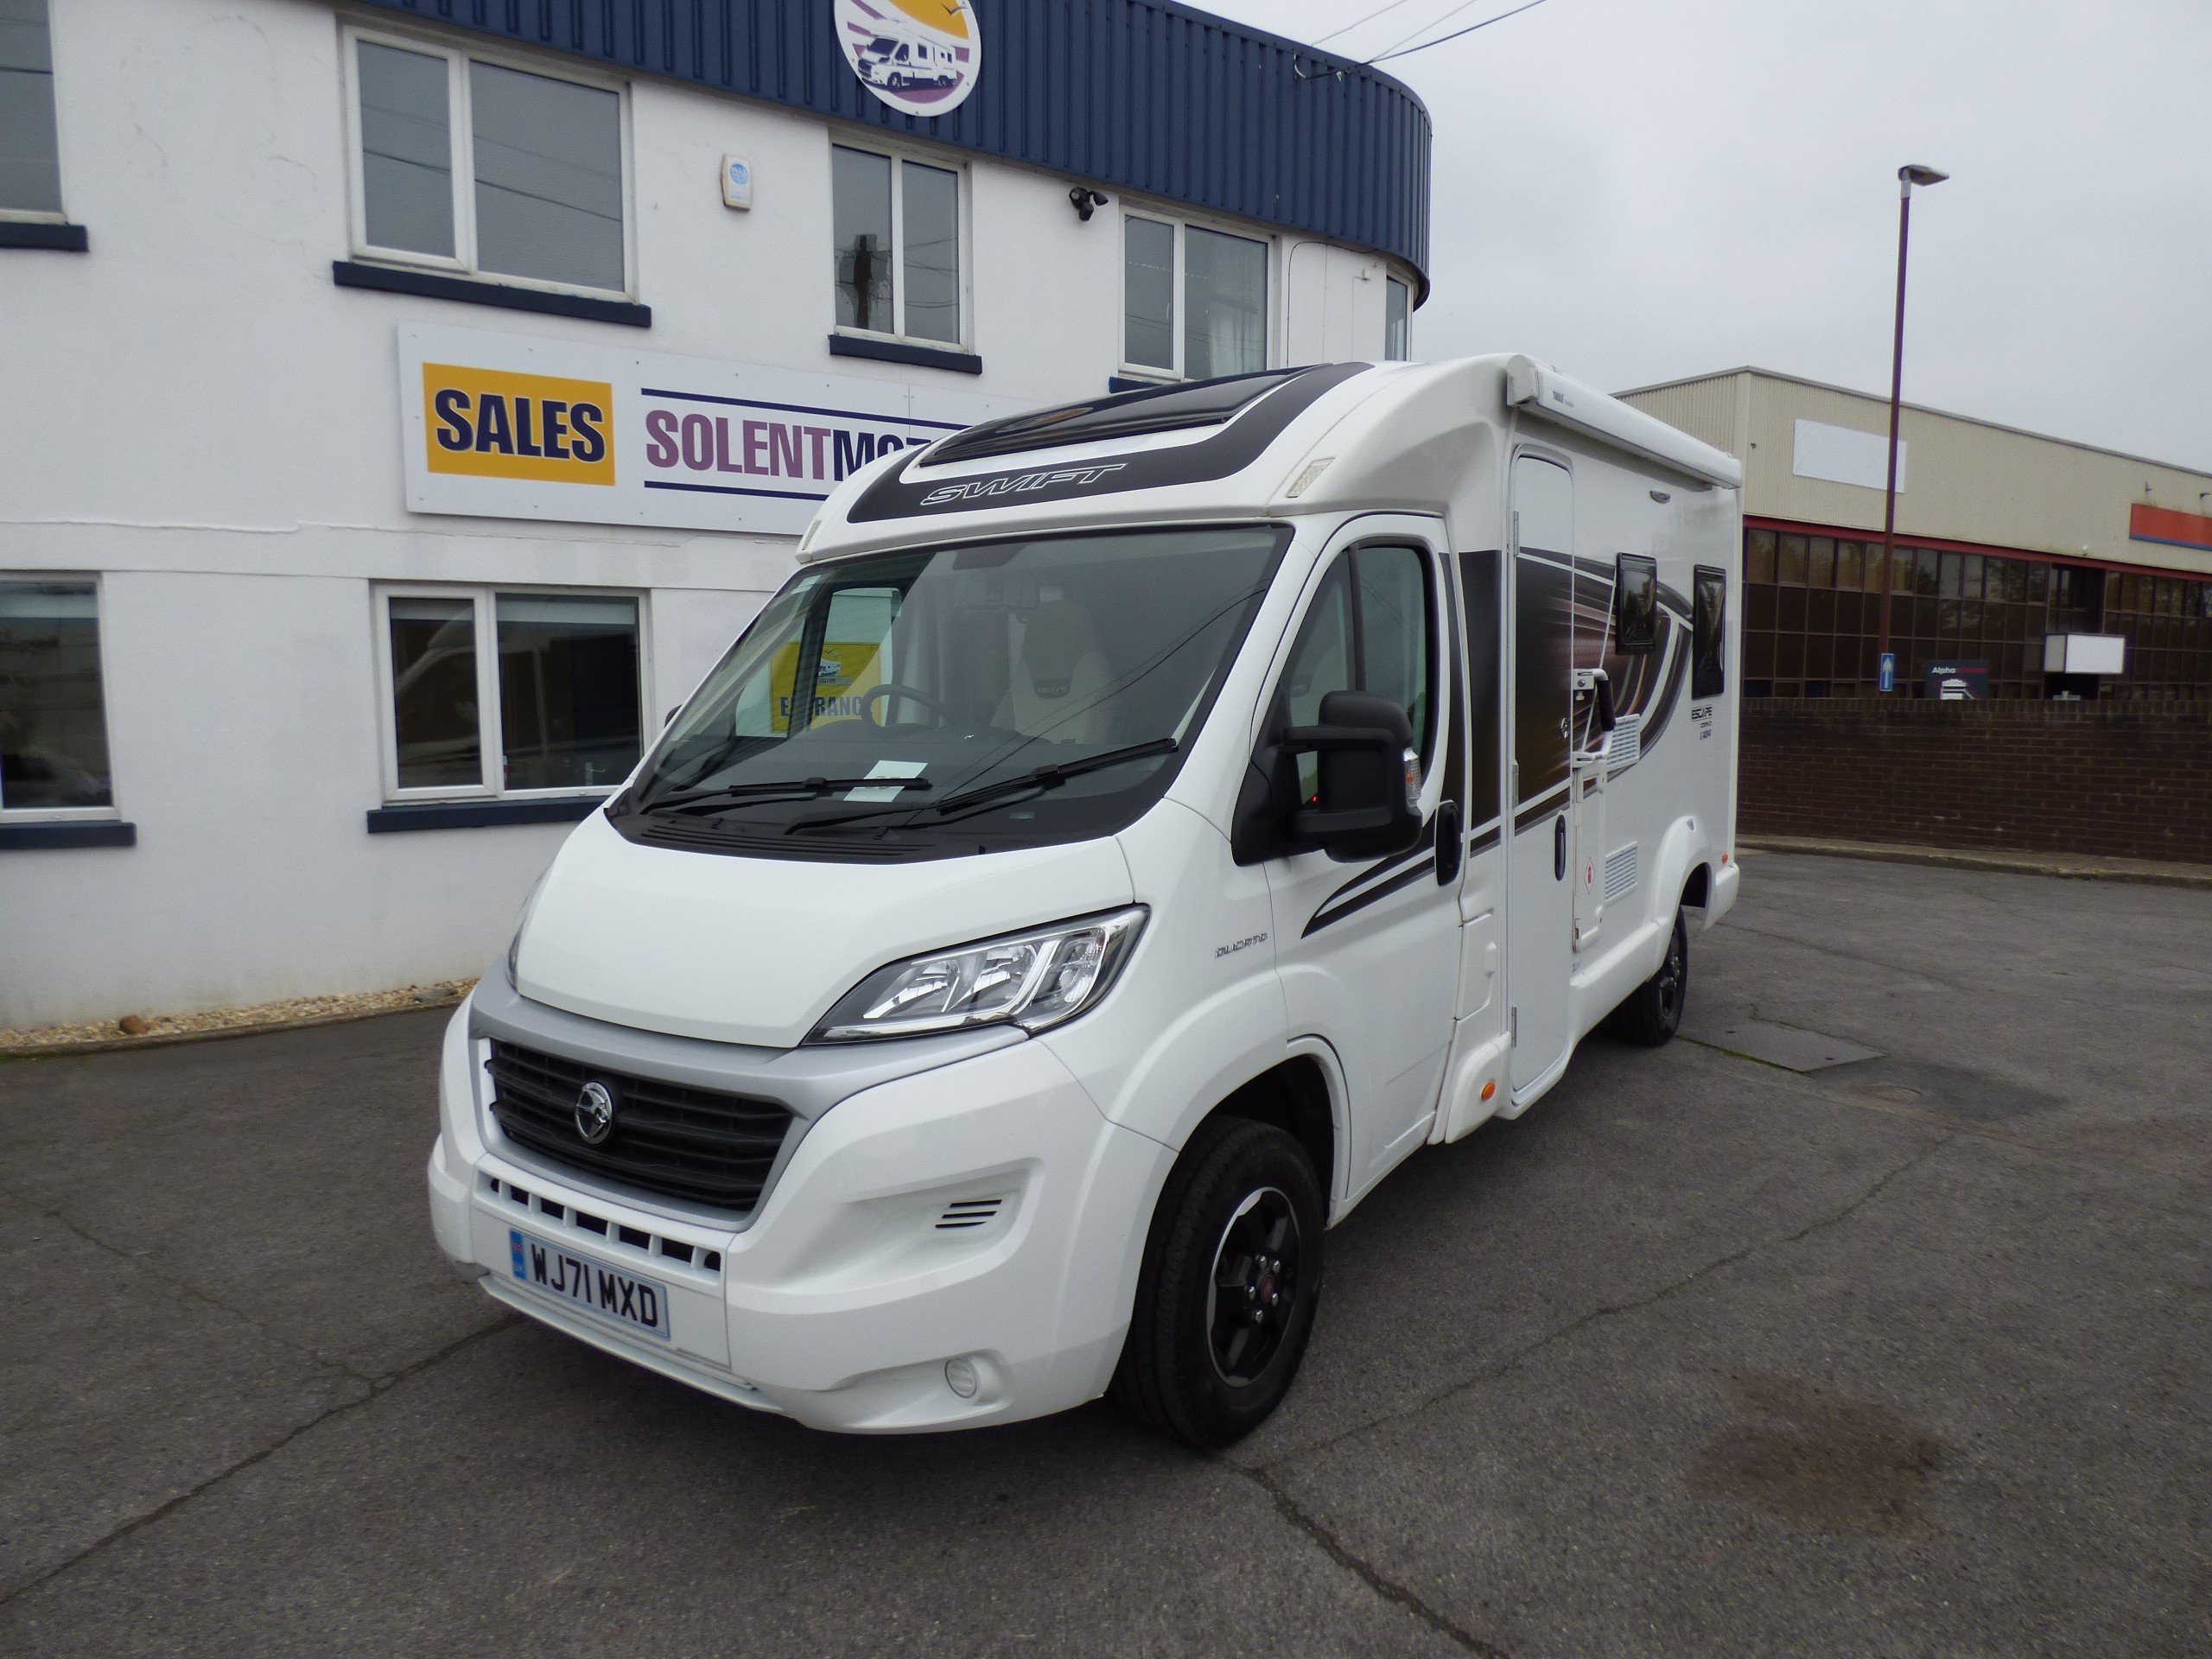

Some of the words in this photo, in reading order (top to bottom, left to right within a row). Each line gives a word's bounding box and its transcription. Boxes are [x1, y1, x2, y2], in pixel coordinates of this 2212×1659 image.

[434, 387, 606, 464] SALES
[644, 409, 932, 483] SOLENTM
[919, 462, 1128, 506] SWIFT
[1931, 666, 1956, 675] Alpha
[779, 696, 873, 717] ERANC
[531, 1243, 592, 1304] WJ71
[598, 1268, 658, 1328] MXD
